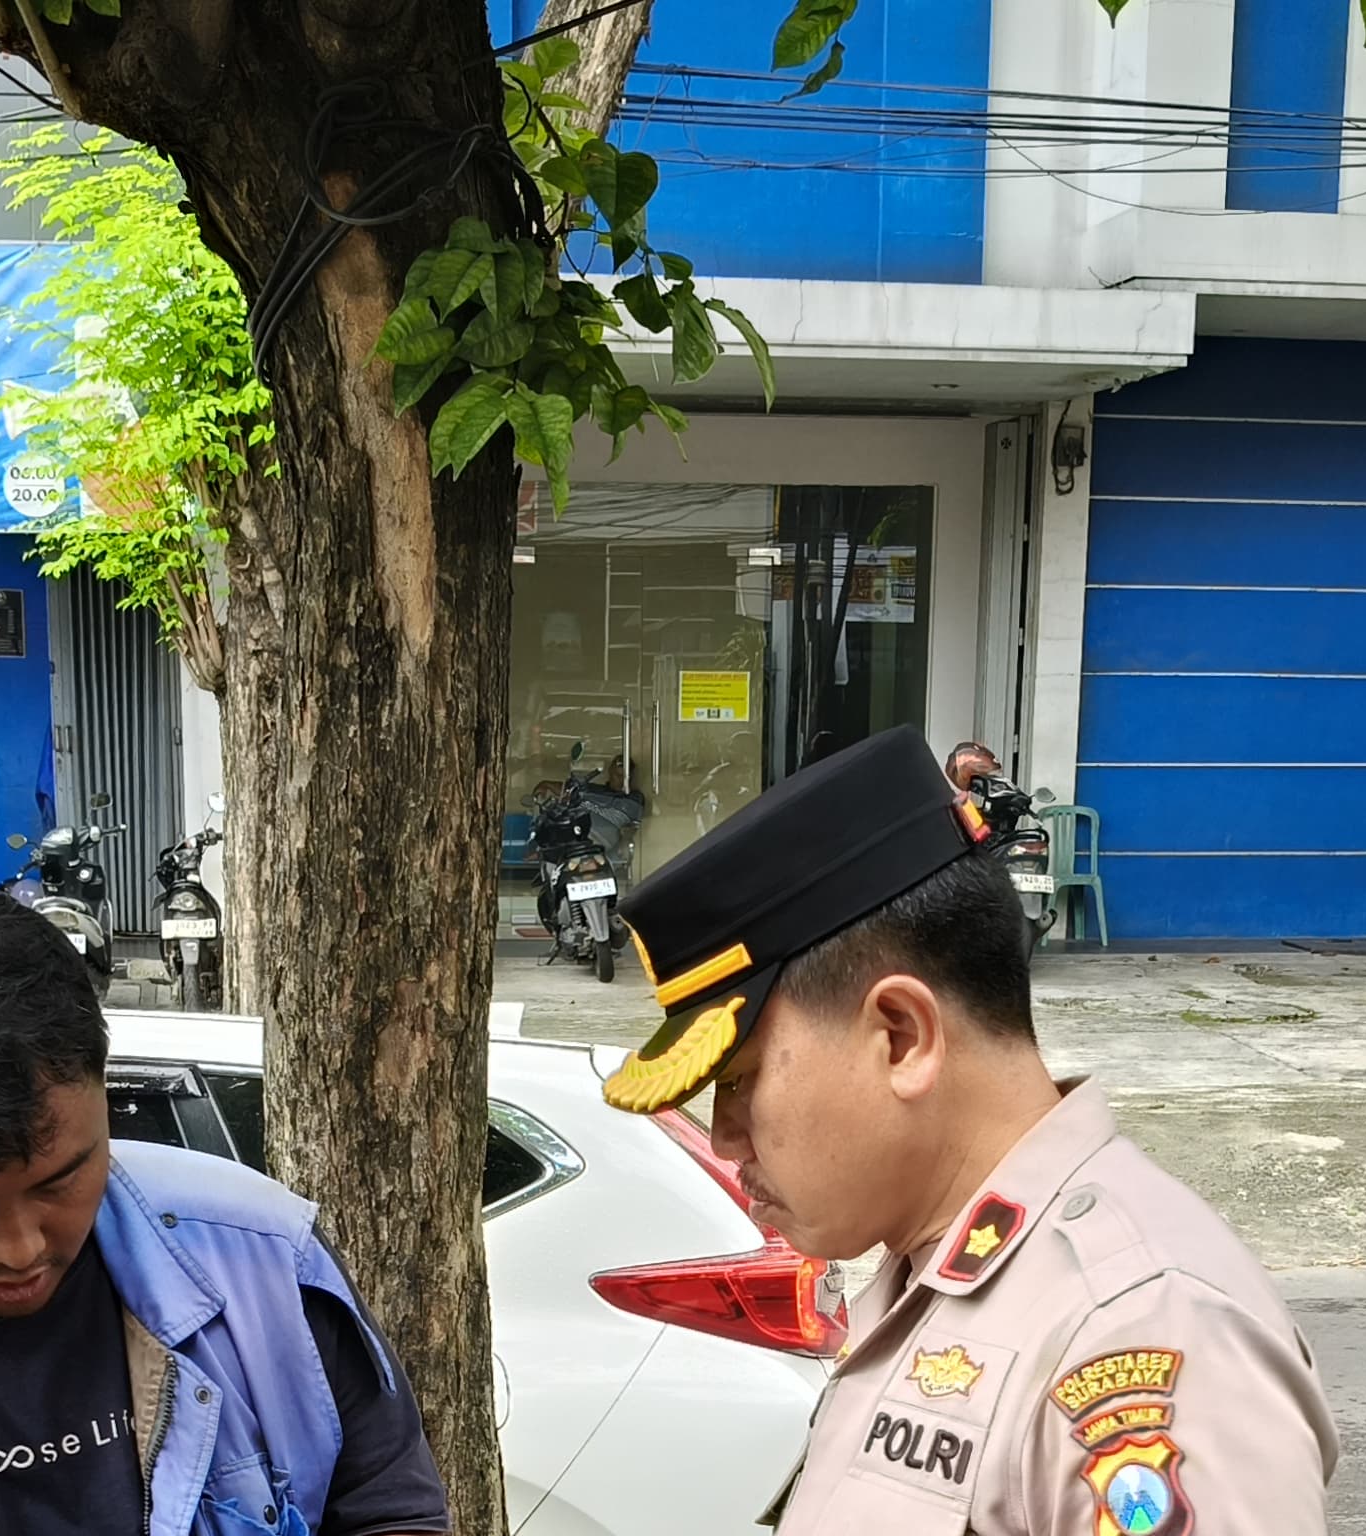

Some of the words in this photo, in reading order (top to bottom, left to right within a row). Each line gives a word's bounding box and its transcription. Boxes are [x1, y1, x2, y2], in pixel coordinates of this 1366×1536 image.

[1055, 1352, 1174, 1400] POLRESTABES
[1065, 1369, 1164, 1409] SURABAYA
[864, 1411, 973, 1484] POLRI
[1084, 1415, 1120, 1442] JAWA
